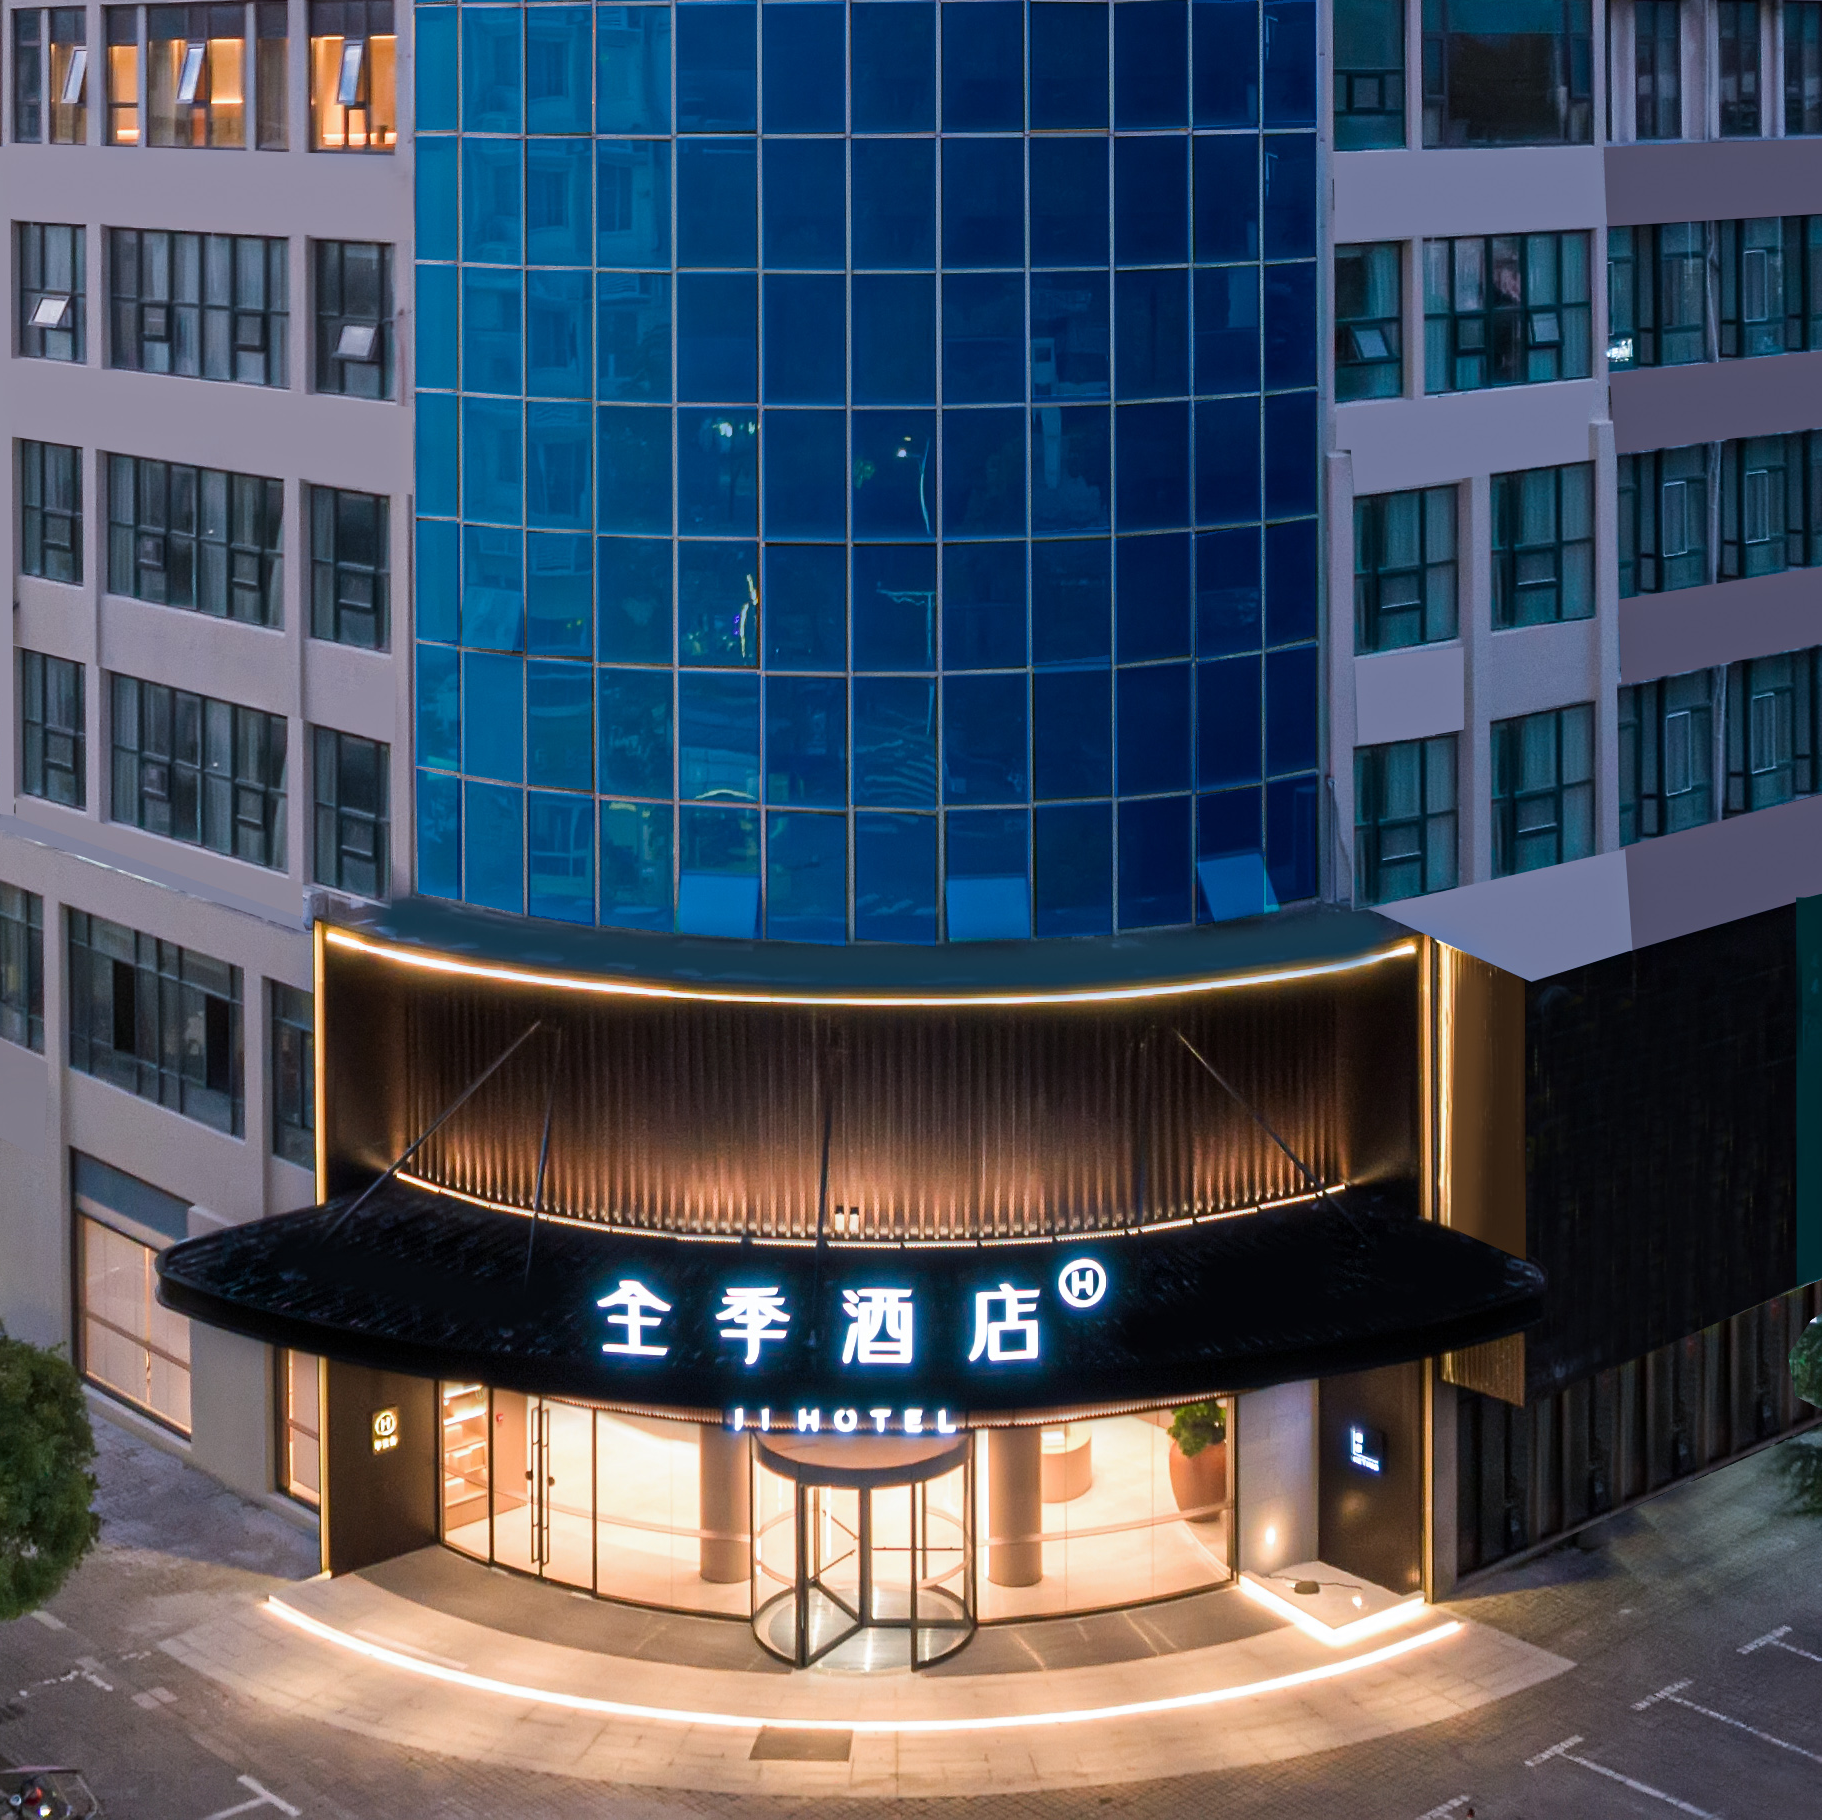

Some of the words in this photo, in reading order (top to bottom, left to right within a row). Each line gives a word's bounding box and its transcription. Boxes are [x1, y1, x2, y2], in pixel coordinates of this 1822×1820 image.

[596, 1280, 1041, 1366] 全季酒店
[797, 1408, 957, 1434] HOTEL
